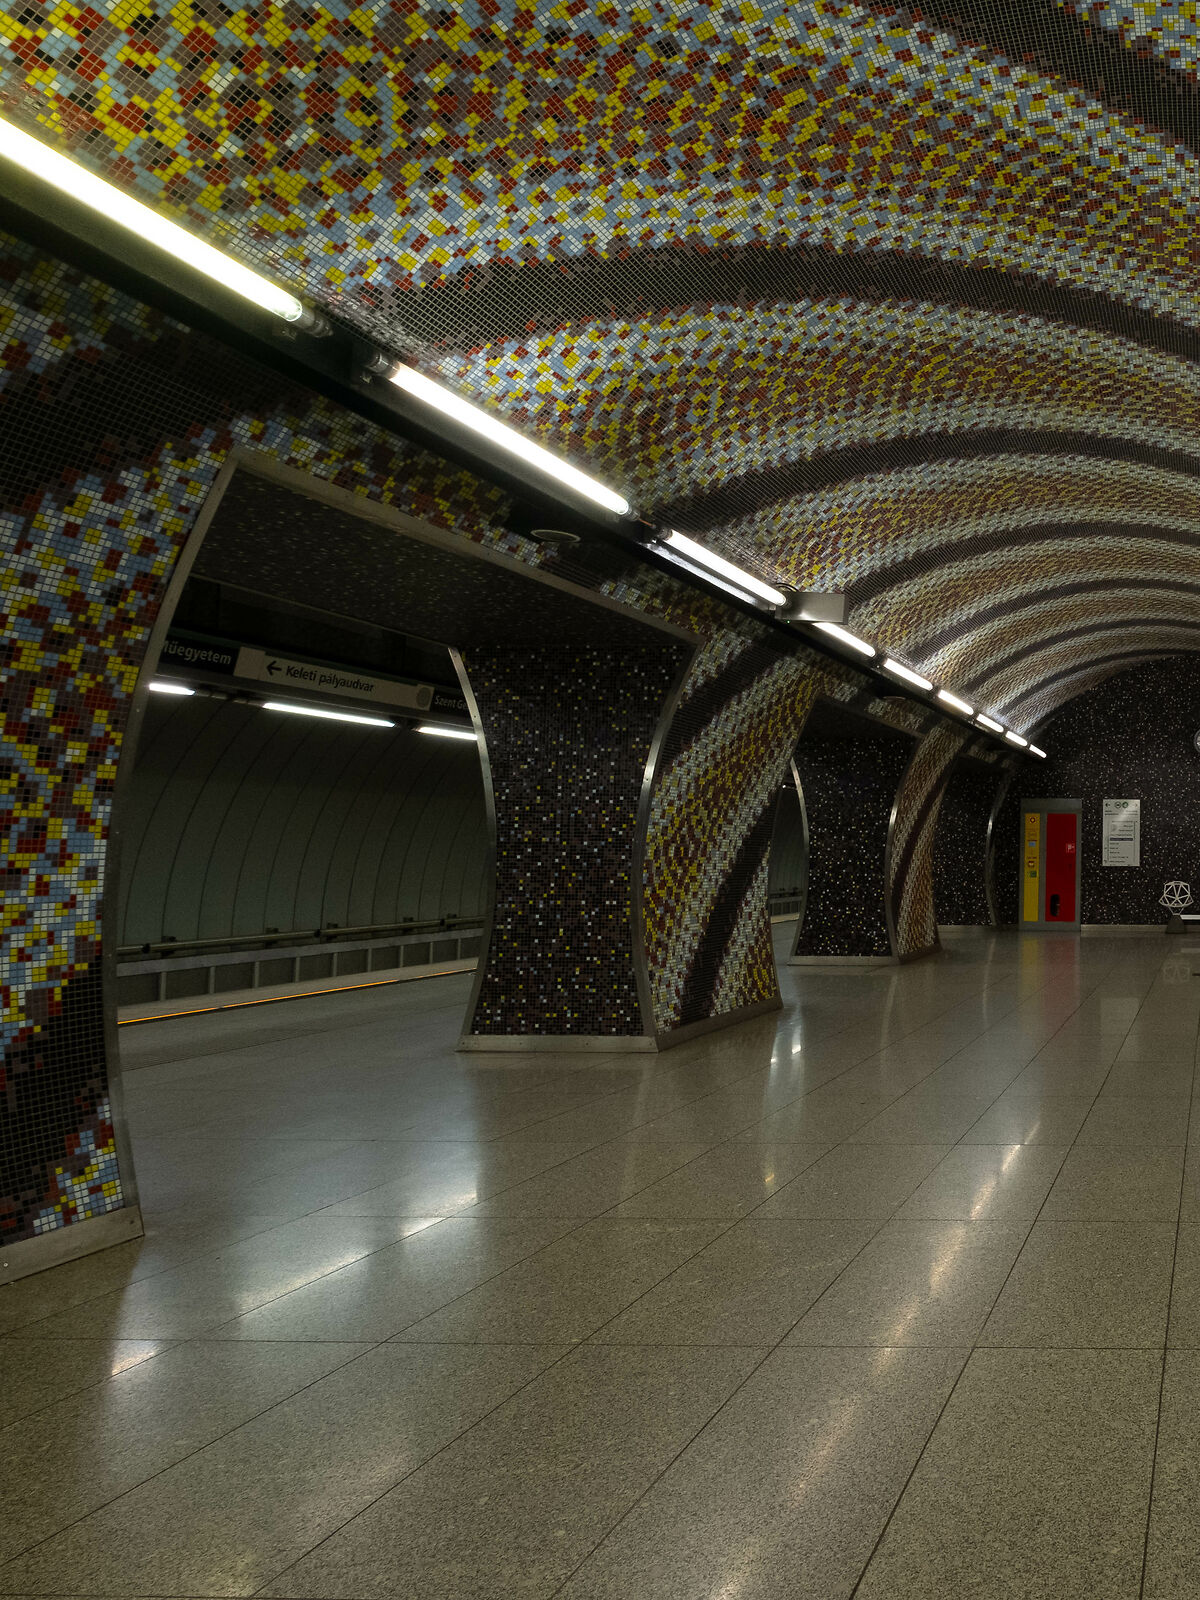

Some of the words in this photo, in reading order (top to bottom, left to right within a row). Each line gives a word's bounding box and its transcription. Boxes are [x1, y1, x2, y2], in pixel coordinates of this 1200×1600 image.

[286, 665, 318, 681] Keleti
[319, 673, 374, 691] pályaudvar
[434, 695, 457, 708] Szent
